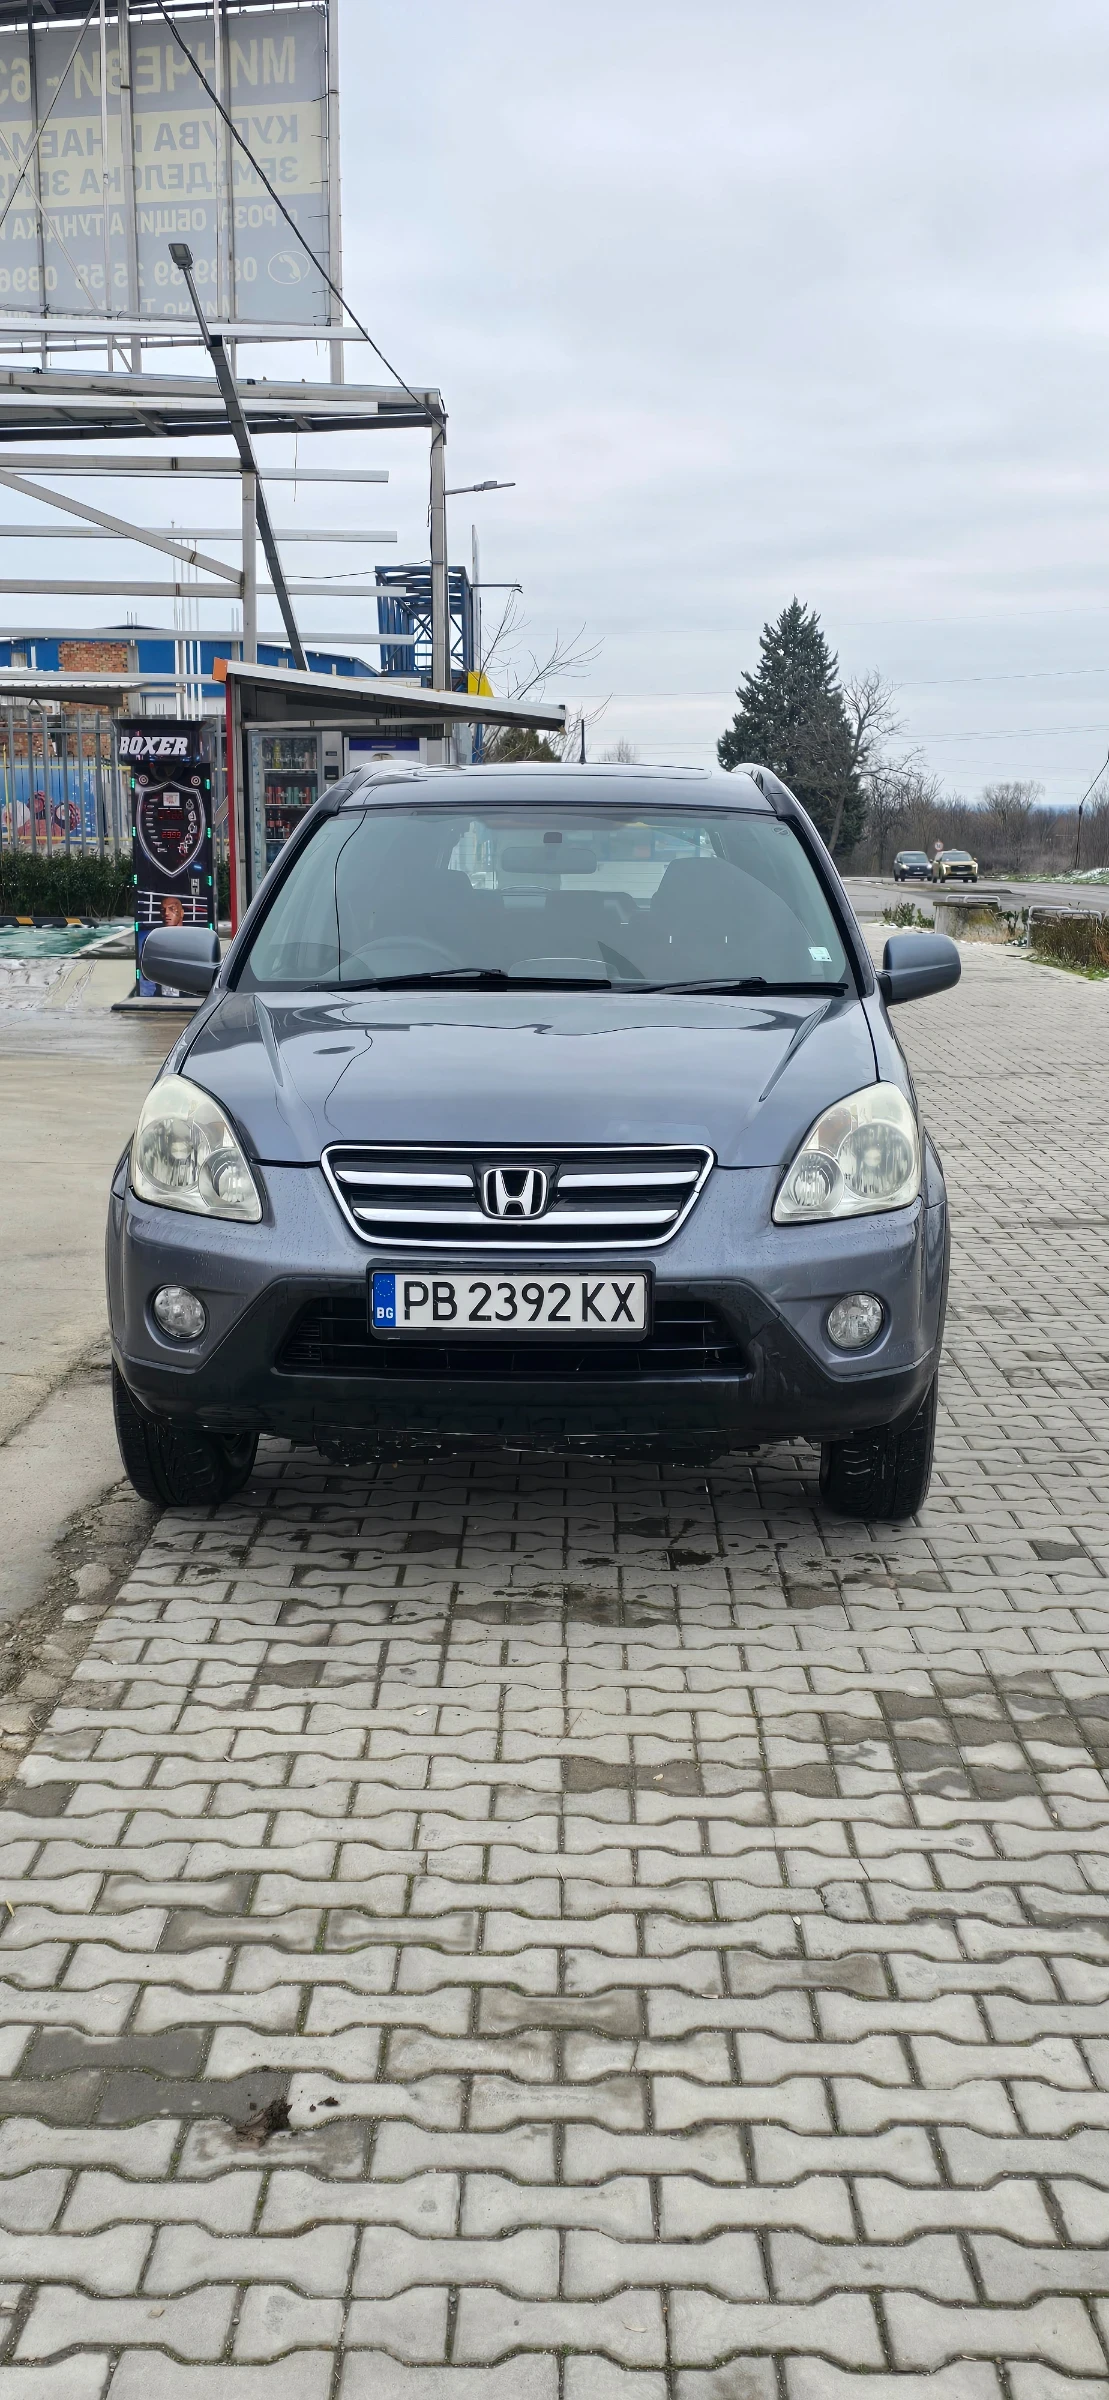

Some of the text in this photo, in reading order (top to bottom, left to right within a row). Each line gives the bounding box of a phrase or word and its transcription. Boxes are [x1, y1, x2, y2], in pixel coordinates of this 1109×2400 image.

[119, 736, 188, 755] BOXER
[403, 1280, 636, 1322] PB 2392 KX
[376, 1306, 394, 1319] BG
